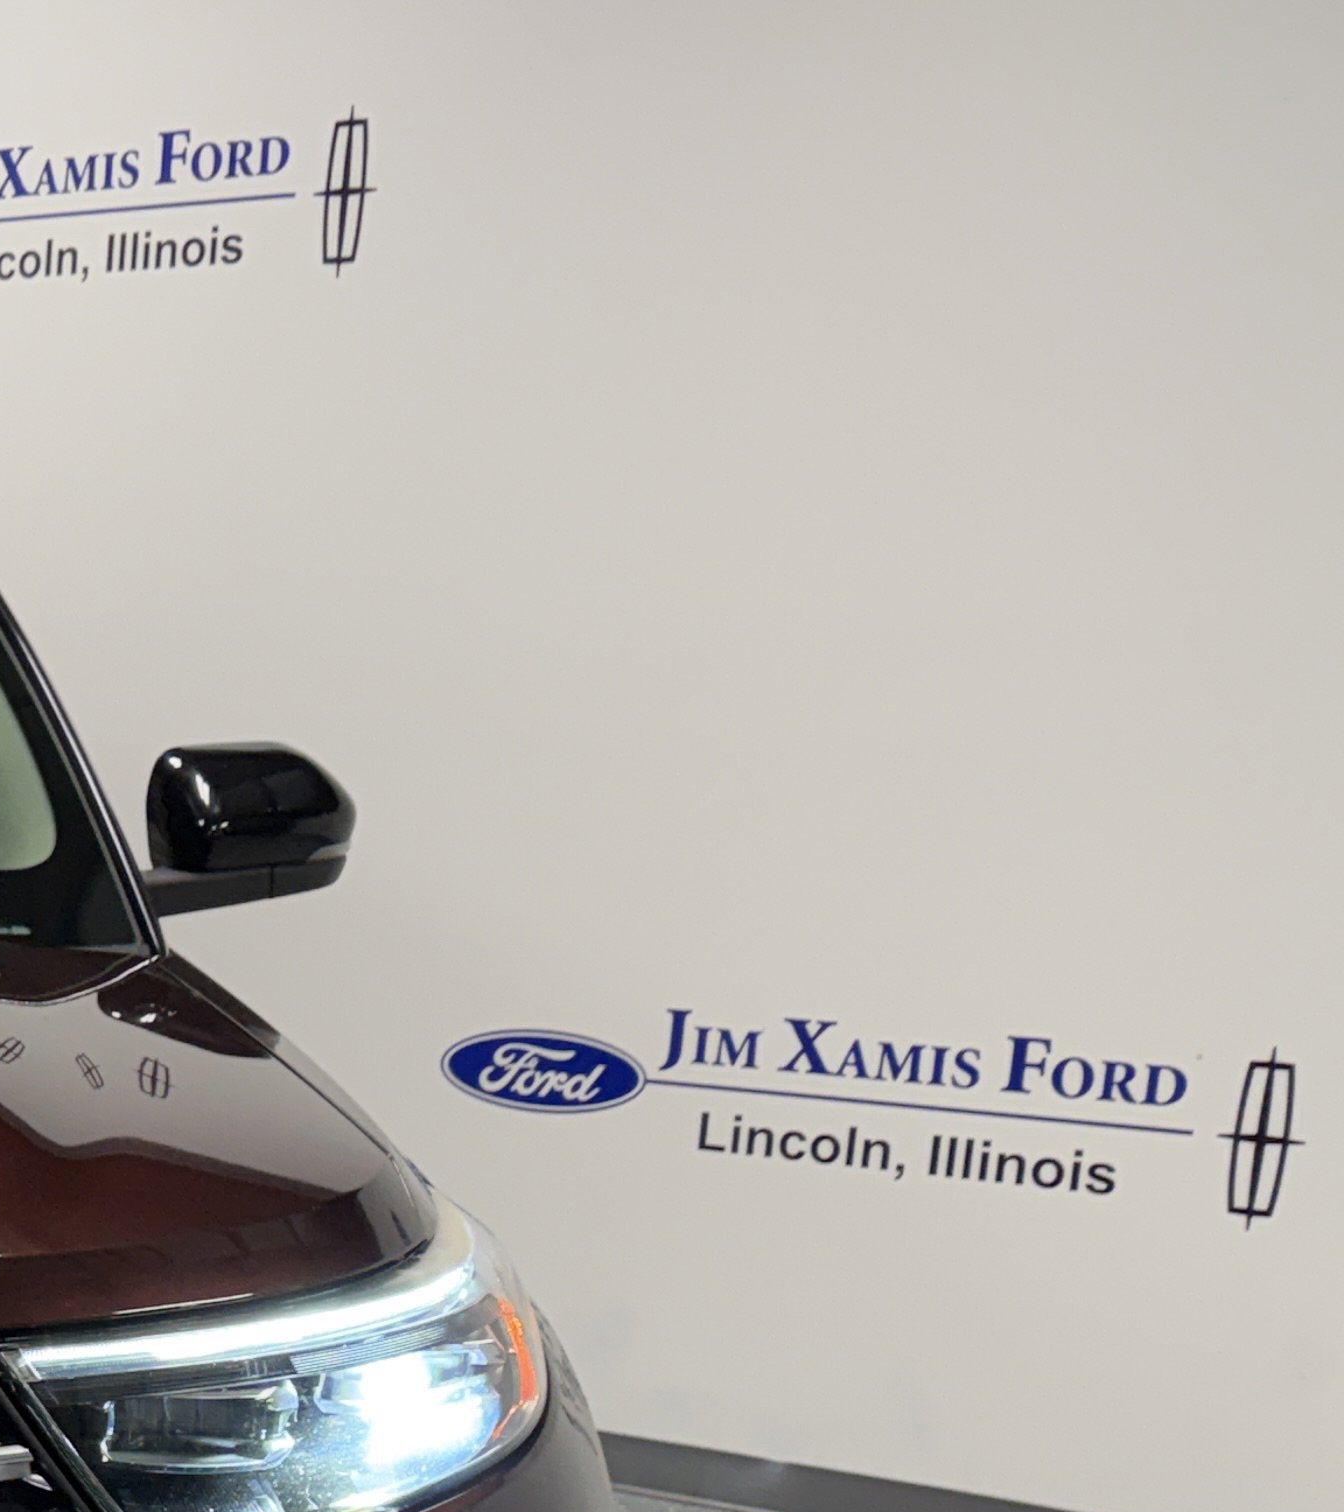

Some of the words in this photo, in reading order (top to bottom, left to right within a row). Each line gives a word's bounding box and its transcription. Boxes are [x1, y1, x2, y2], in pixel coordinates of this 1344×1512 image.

[107, 226, 243, 272] Illinois
[479, 1042, 601, 1103] Ford
[697, 1112, 907, 1180] Lincoln,
[928, 1135, 1116, 1195] Illinois
